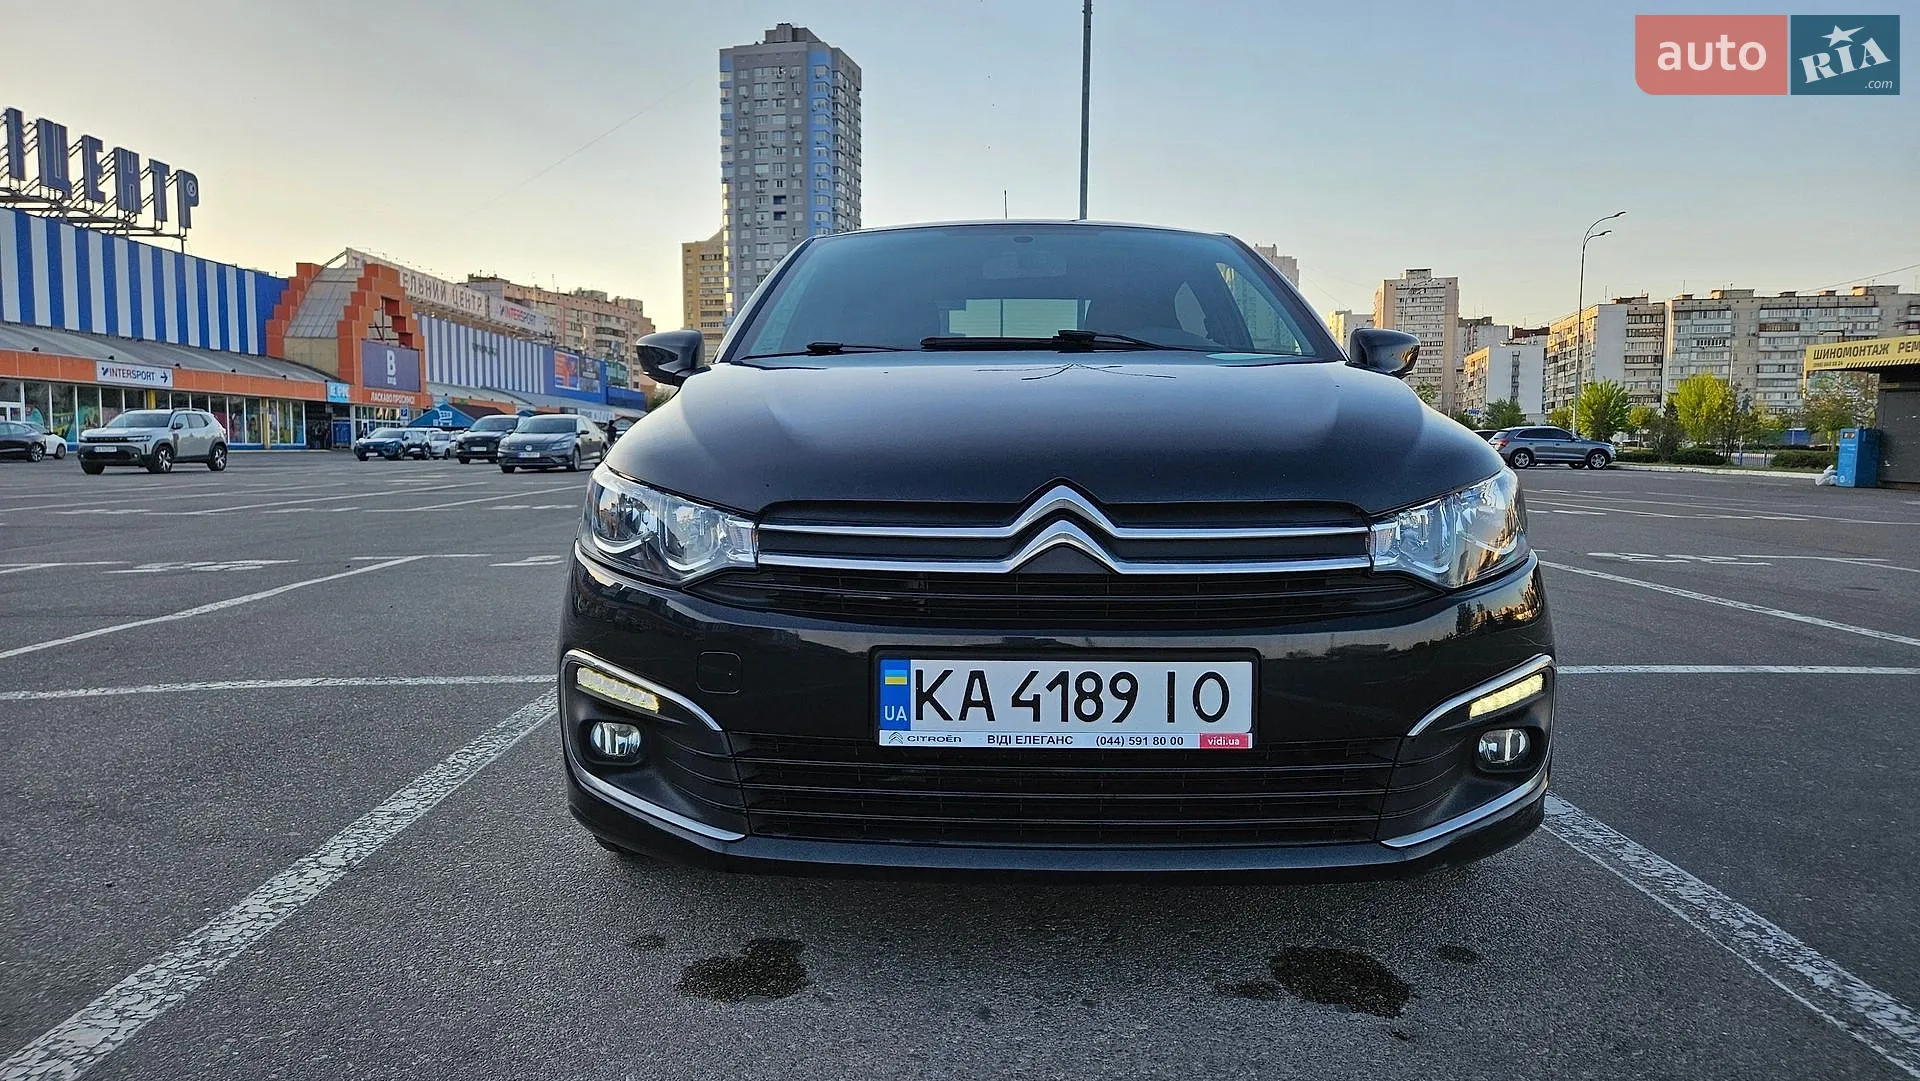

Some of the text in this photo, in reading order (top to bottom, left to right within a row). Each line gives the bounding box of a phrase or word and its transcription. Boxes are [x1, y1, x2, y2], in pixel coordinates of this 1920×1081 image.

[452, 287, 483, 314] ЦЕНТР
[1813, 343, 1889, 360] ШИНОМОНТАЖ
[109, 367, 155, 381] INTERSPORT
[915, 669, 996, 722] KA
[1011, 670, 1138, 723] 4189
[884, 705, 907, 721] UA
[987, 735, 1074, 746] ВІДІ ЕЛЕГАНС
[1096, 735, 1184, 746] (044) 591 80 00
